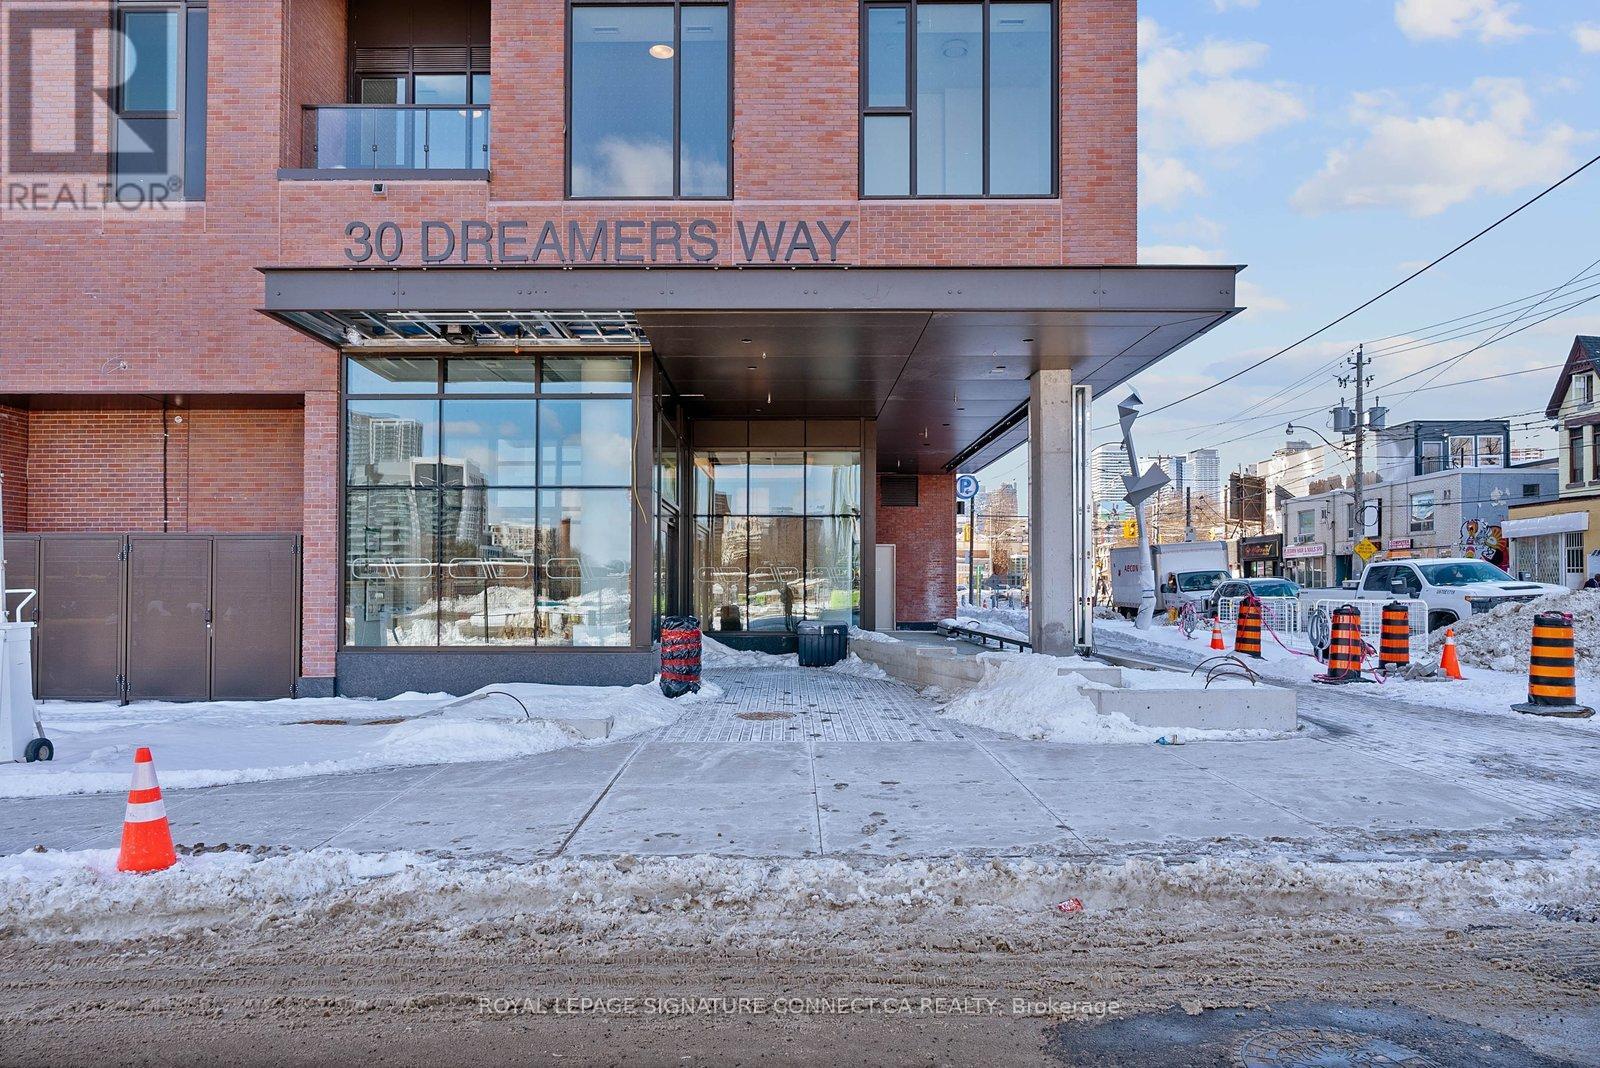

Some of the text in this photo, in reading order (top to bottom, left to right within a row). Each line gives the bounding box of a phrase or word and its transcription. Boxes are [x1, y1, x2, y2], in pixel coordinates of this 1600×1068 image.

[344, 219, 851, 262] 30 DREAMERS WAY
[960, 478, 972, 494] P
[1124, 564, 1139, 572] AECON
